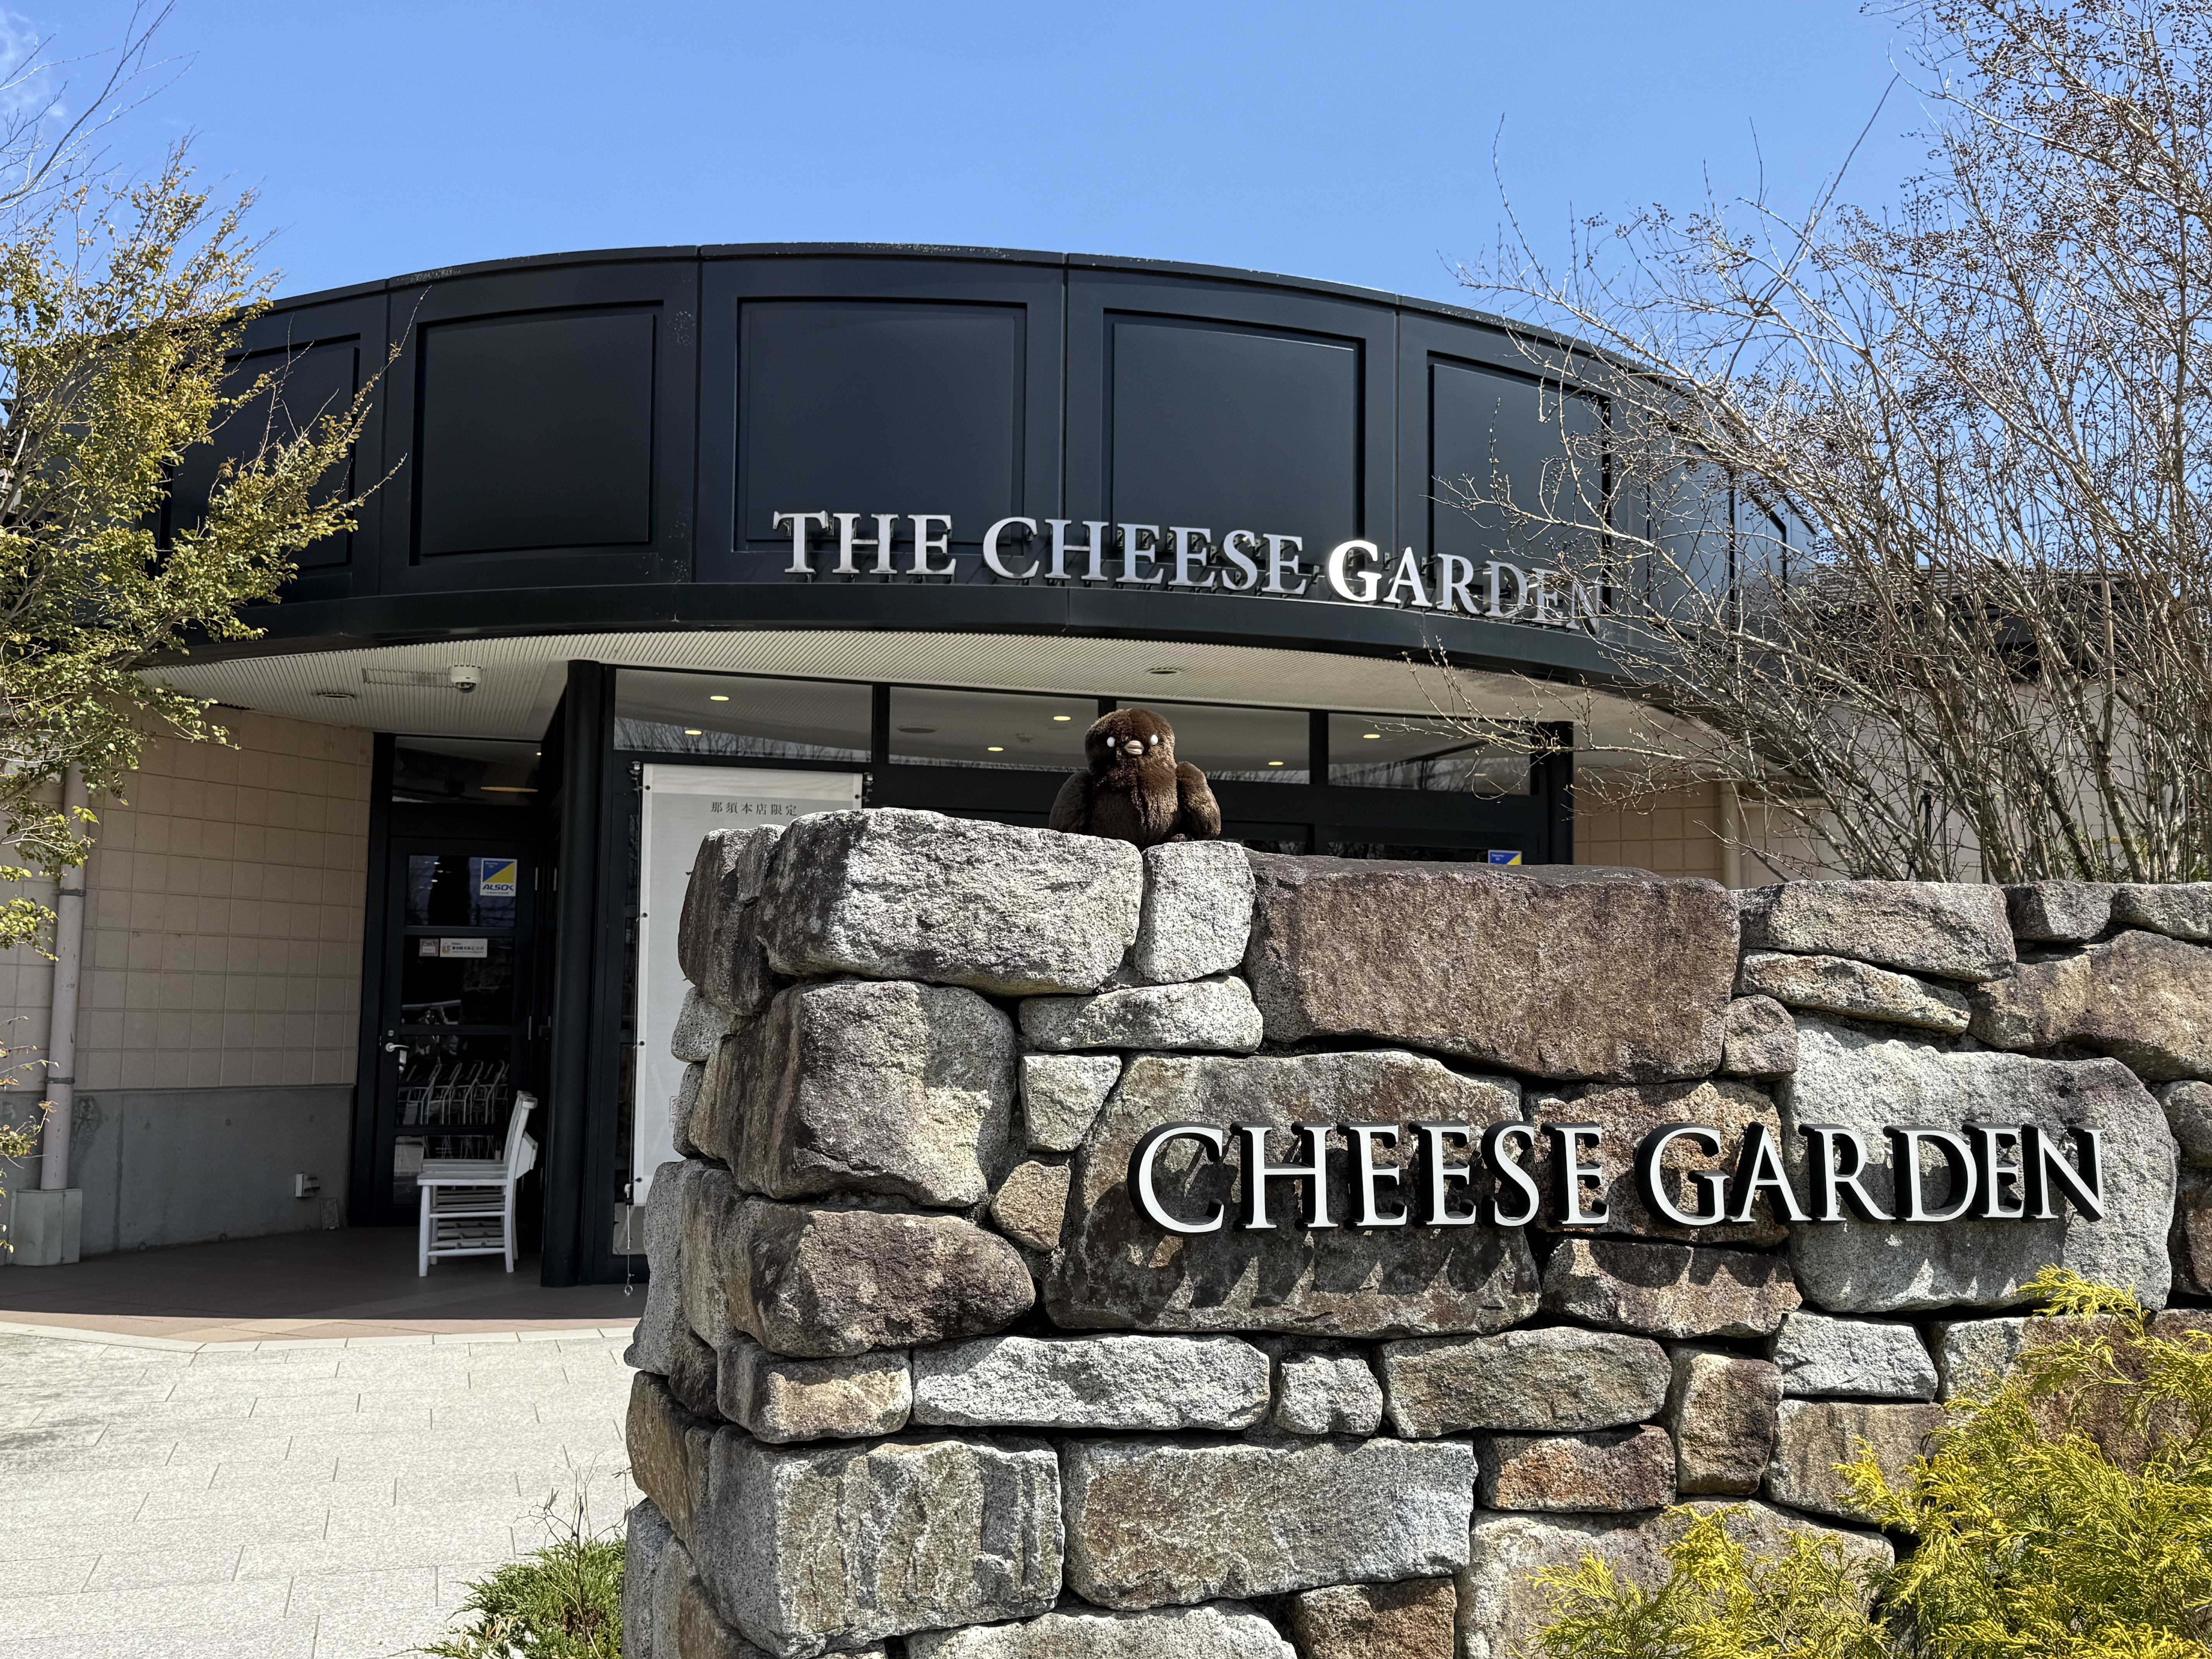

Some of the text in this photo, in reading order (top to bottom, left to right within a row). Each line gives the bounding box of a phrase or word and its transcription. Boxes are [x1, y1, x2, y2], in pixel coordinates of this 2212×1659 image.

[773, 510, 1602, 634] THE CHEESE GARDEN
[711, 801, 798, 816] 那須本店限定
[1128, 1121, 2105, 1234] CHEESE GARDEN
